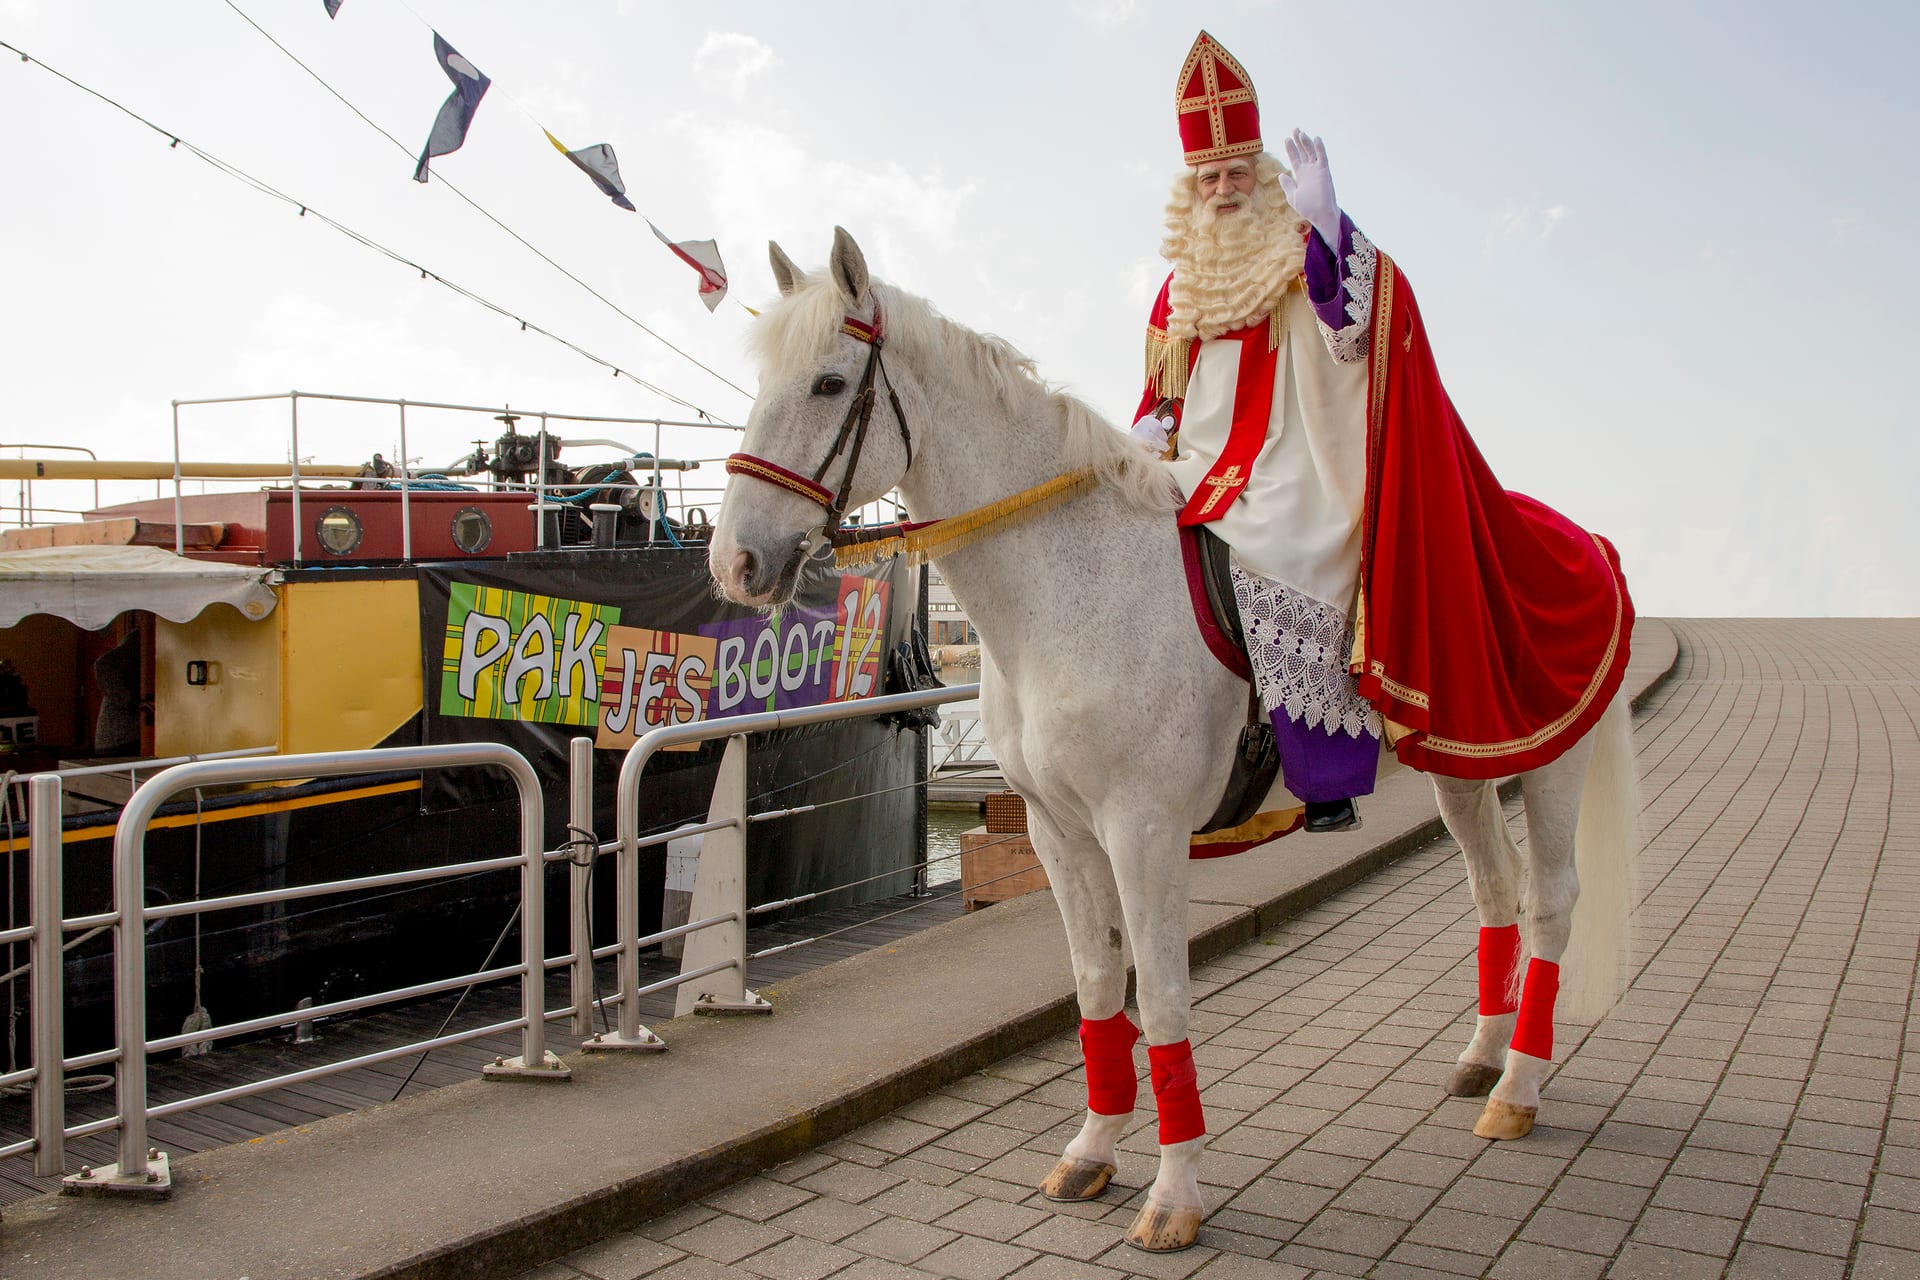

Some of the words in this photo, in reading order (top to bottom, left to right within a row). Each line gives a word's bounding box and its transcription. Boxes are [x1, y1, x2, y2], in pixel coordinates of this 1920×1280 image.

[458, 610, 605, 704] PAK
[605, 648, 706, 737] JES
[718, 620, 836, 711] BOOT
[835, 590, 882, 699] 12
